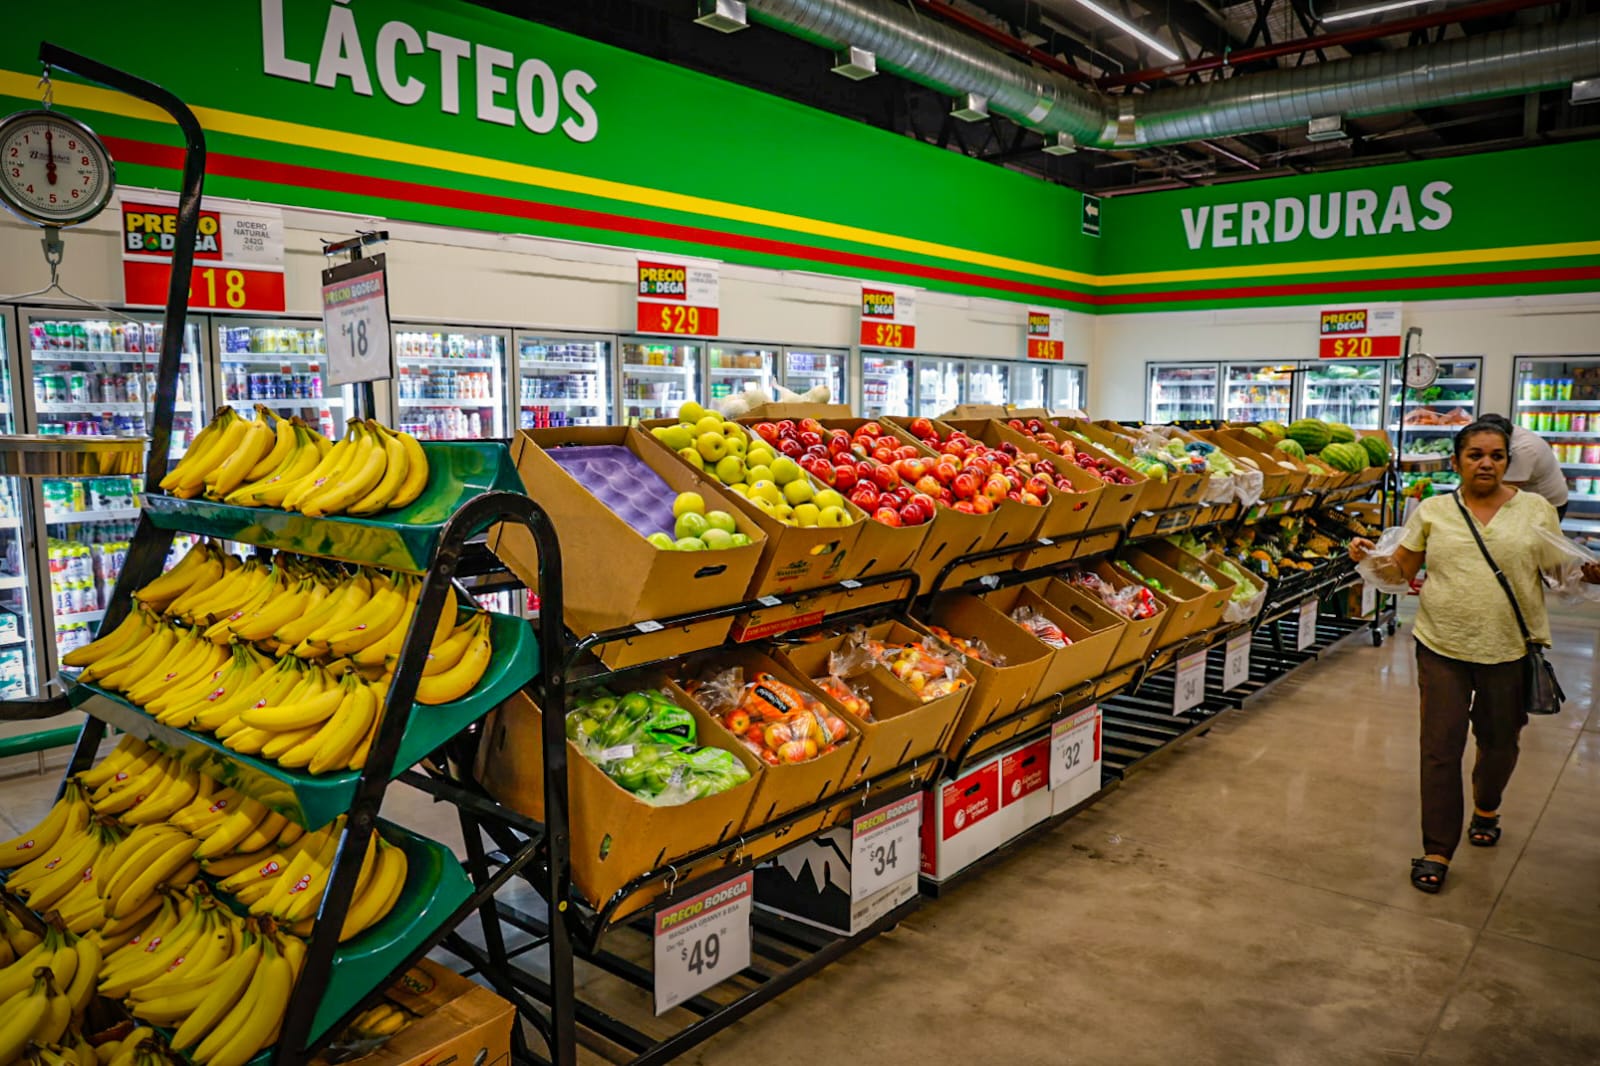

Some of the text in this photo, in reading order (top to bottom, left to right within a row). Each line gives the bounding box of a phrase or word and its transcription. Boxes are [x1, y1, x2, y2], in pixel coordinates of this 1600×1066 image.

[261, 0, 599, 143] LÁCTEOS
[68, 140, 76, 150] 9
[10, 147, 18, 158] 2
[81, 156, 89, 166] 8
[12, 168, 20, 178] 3
[82, 175, 90, 185] 7
[26, 184, 35, 194] 4
[71, 189, 79, 198] 6
[49, 194, 57, 203] 5
[1181, 181, 1454, 250] VERDURAS
[126, 213, 218, 235] PREO
[233, 228, 271, 239] NATURAL
[640, 268, 685, 282] PRECIO
[188, 268, 247, 308] 18
[661, 306, 699, 334] $29
[1322, 311, 1366, 324] PRECIO
[876, 323, 903, 347] $25
[1334, 337, 1373, 358] $20
[661, 881, 748, 930] PRECIO BODEGA
[681, 933, 720, 976] $49
